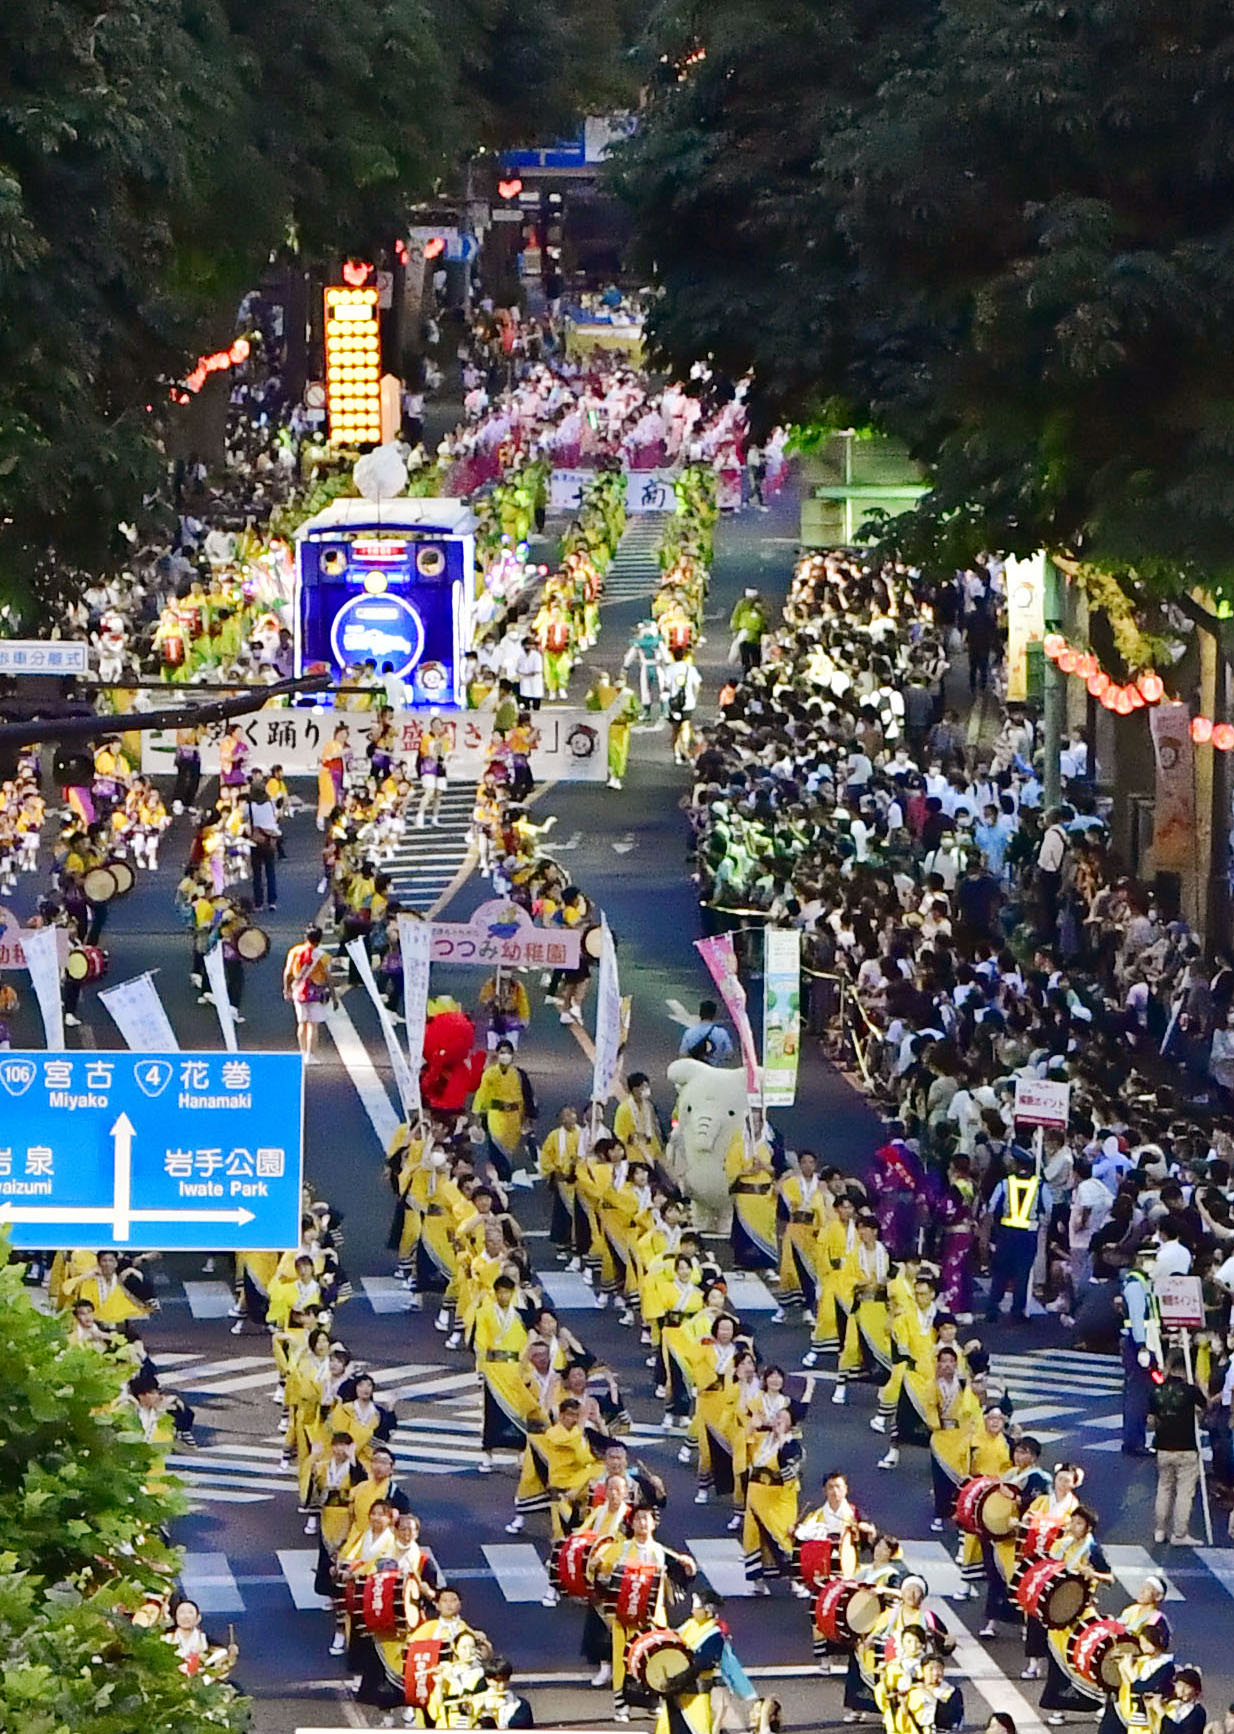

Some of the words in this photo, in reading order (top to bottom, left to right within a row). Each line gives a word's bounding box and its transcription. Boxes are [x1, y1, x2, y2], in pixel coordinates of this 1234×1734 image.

[434, 938, 566, 964] つつみ幼稚園
[5, 1066, 30, 1083] 106
[44, 1060, 115, 1089] 宮古
[145, 1065, 161, 1086] 4
[180, 1060, 251, 1090] 花巻
[49, 1091, 108, 1111] Miyako
[178, 1092, 252, 1109] Hanamaki
[164, 1148, 285, 1178] 岩手公園
[179, 1181, 223, 1197] Iwate
[230, 1181, 268, 1197] Park
